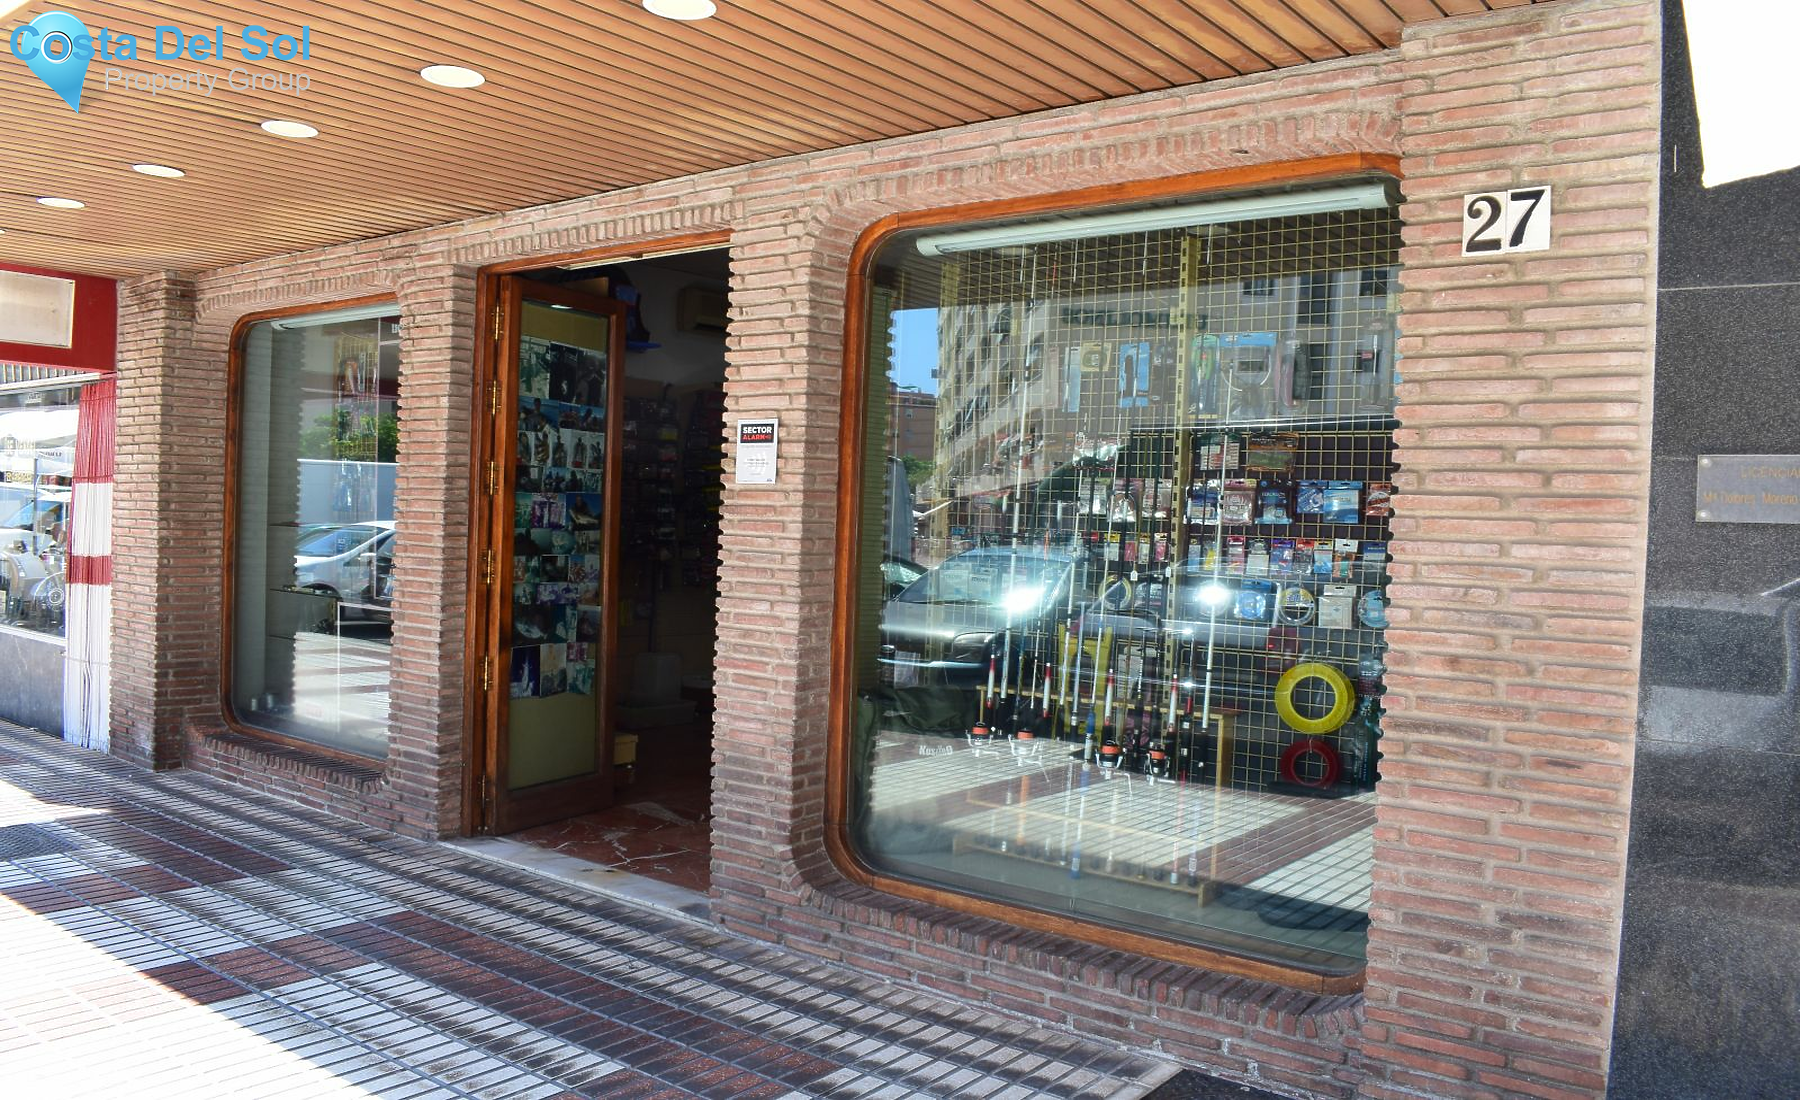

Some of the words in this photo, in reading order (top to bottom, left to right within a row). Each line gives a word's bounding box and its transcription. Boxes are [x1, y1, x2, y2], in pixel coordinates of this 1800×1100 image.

[1466, 189, 1545, 252] 27
[742, 426, 772, 434] SECTOR
[1740, 465, 1800, 479] LICENCIA
